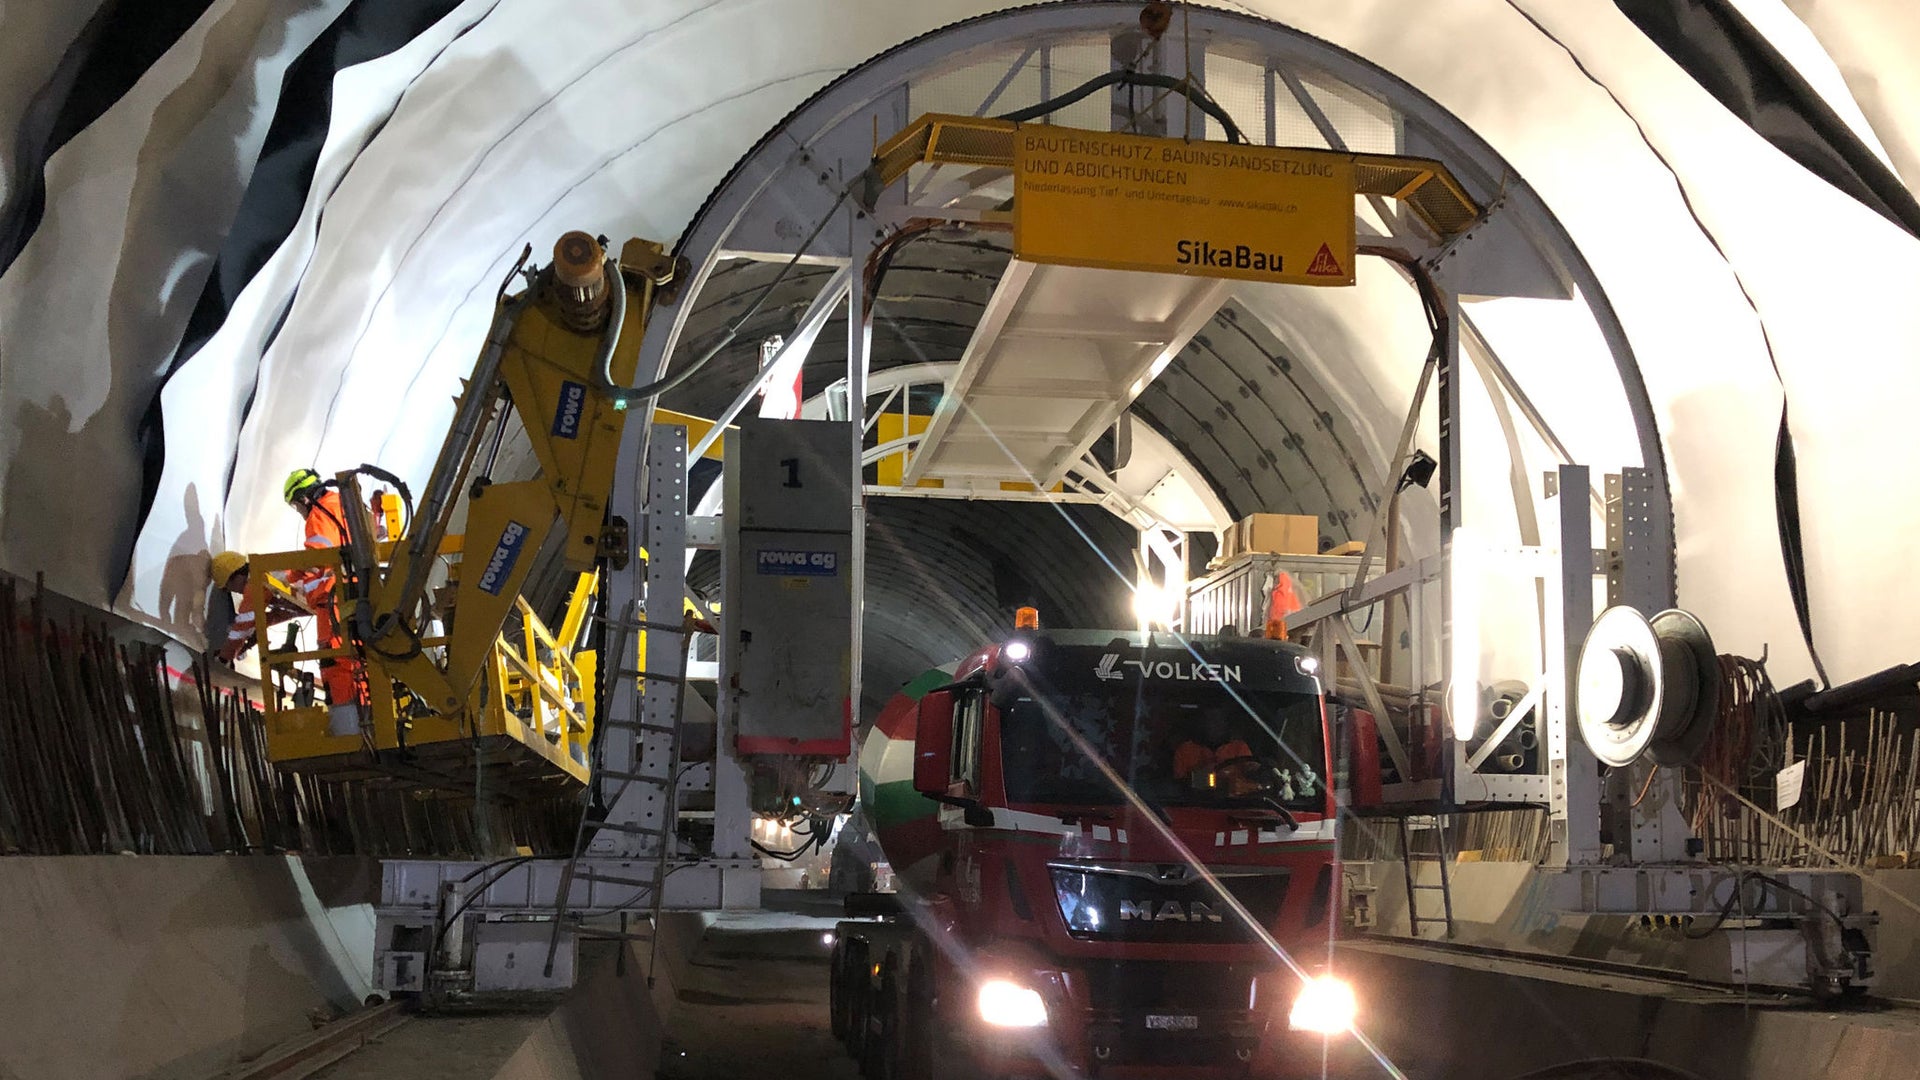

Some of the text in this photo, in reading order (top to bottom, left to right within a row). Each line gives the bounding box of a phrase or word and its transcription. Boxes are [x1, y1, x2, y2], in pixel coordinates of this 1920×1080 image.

[1024, 159, 1187, 185] UND ABDICHTUNGEN
[1161, 148, 1334, 178] BAUINSTANDSETZUNG
[1023, 180, 1097, 198] Niederlassung
[1124, 189, 1145, 200] und
[1176, 240, 1283, 272] SikaBau
[1311, 253, 1339, 274] Sika
[560, 386, 582, 434] rowa
[780, 457, 802, 488] 1
[480, 522, 524, 591] rowa ag
[759, 551, 836, 569] rowa ag
[1123, 660, 1242, 683] VOLKEN
[1119, 900, 1222, 922] MAN
